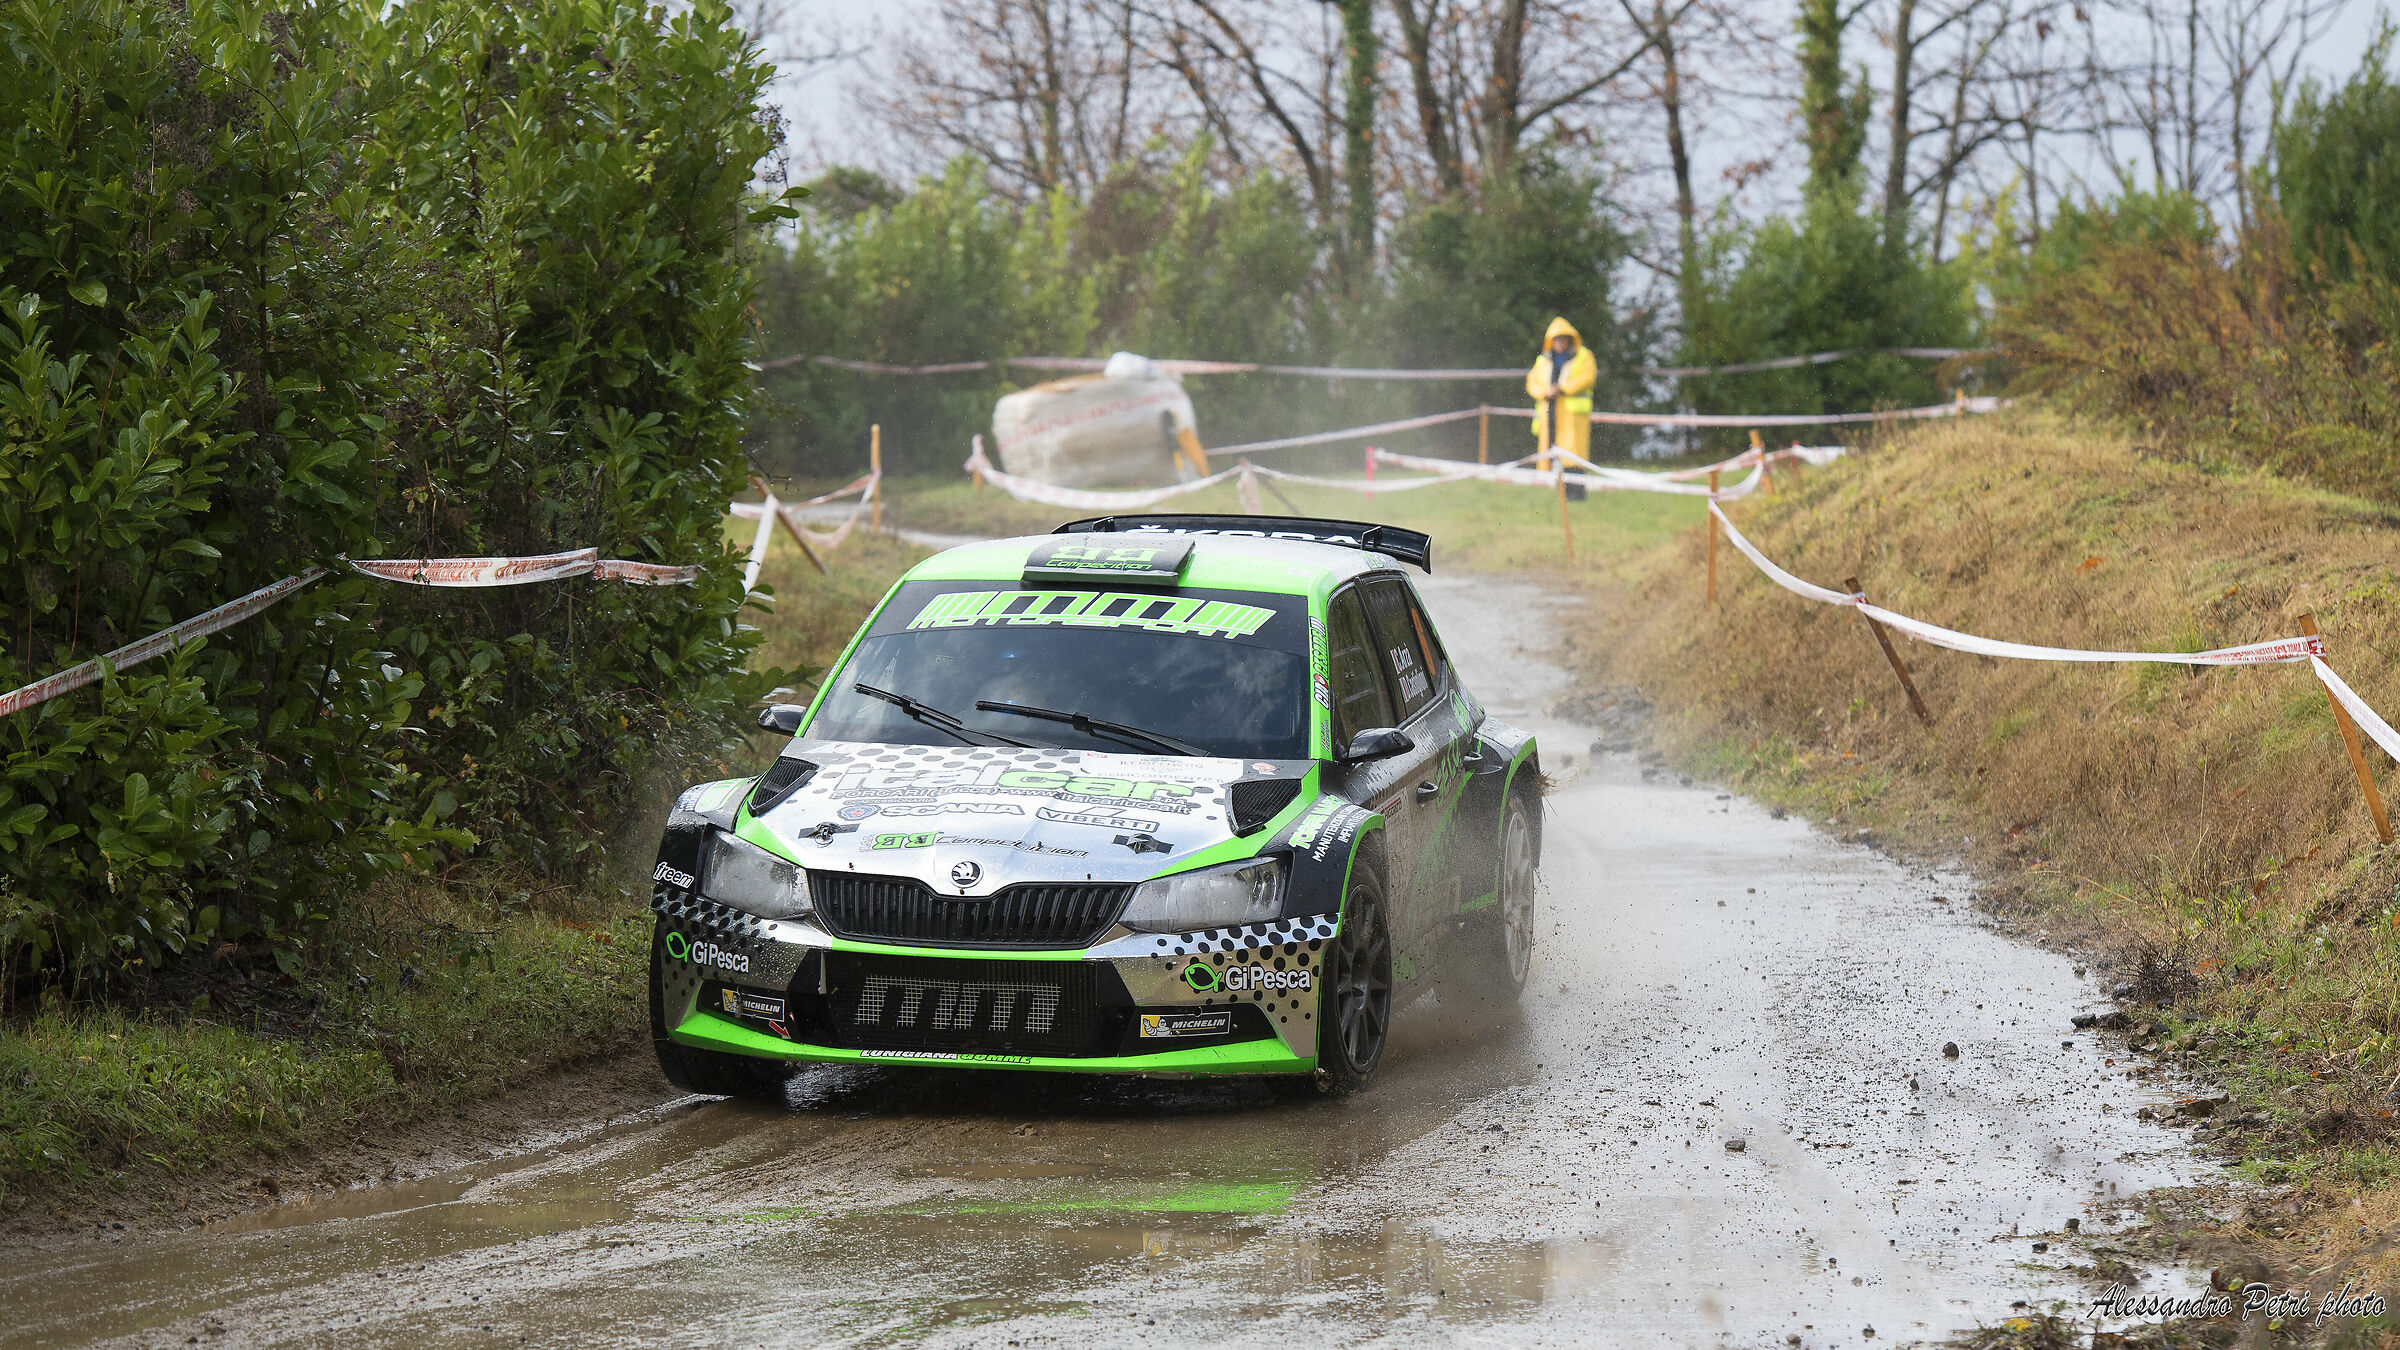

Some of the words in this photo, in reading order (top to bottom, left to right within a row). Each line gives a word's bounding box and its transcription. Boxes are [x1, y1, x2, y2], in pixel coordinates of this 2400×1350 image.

[1046, 559, 1152, 570] Competition
[833, 762, 1194, 800] italcar
[829, 788, 929, 799] PORCARI
[881, 803, 1025, 817] SCANIA
[1045, 810, 1154, 831] VIBERTI
[936, 836, 1090, 858] Competition
[653, 862, 694, 888] freem
[860, 1050, 958, 1060] LUNIGIANA
[958, 1053, 1032, 1064] GOMME
